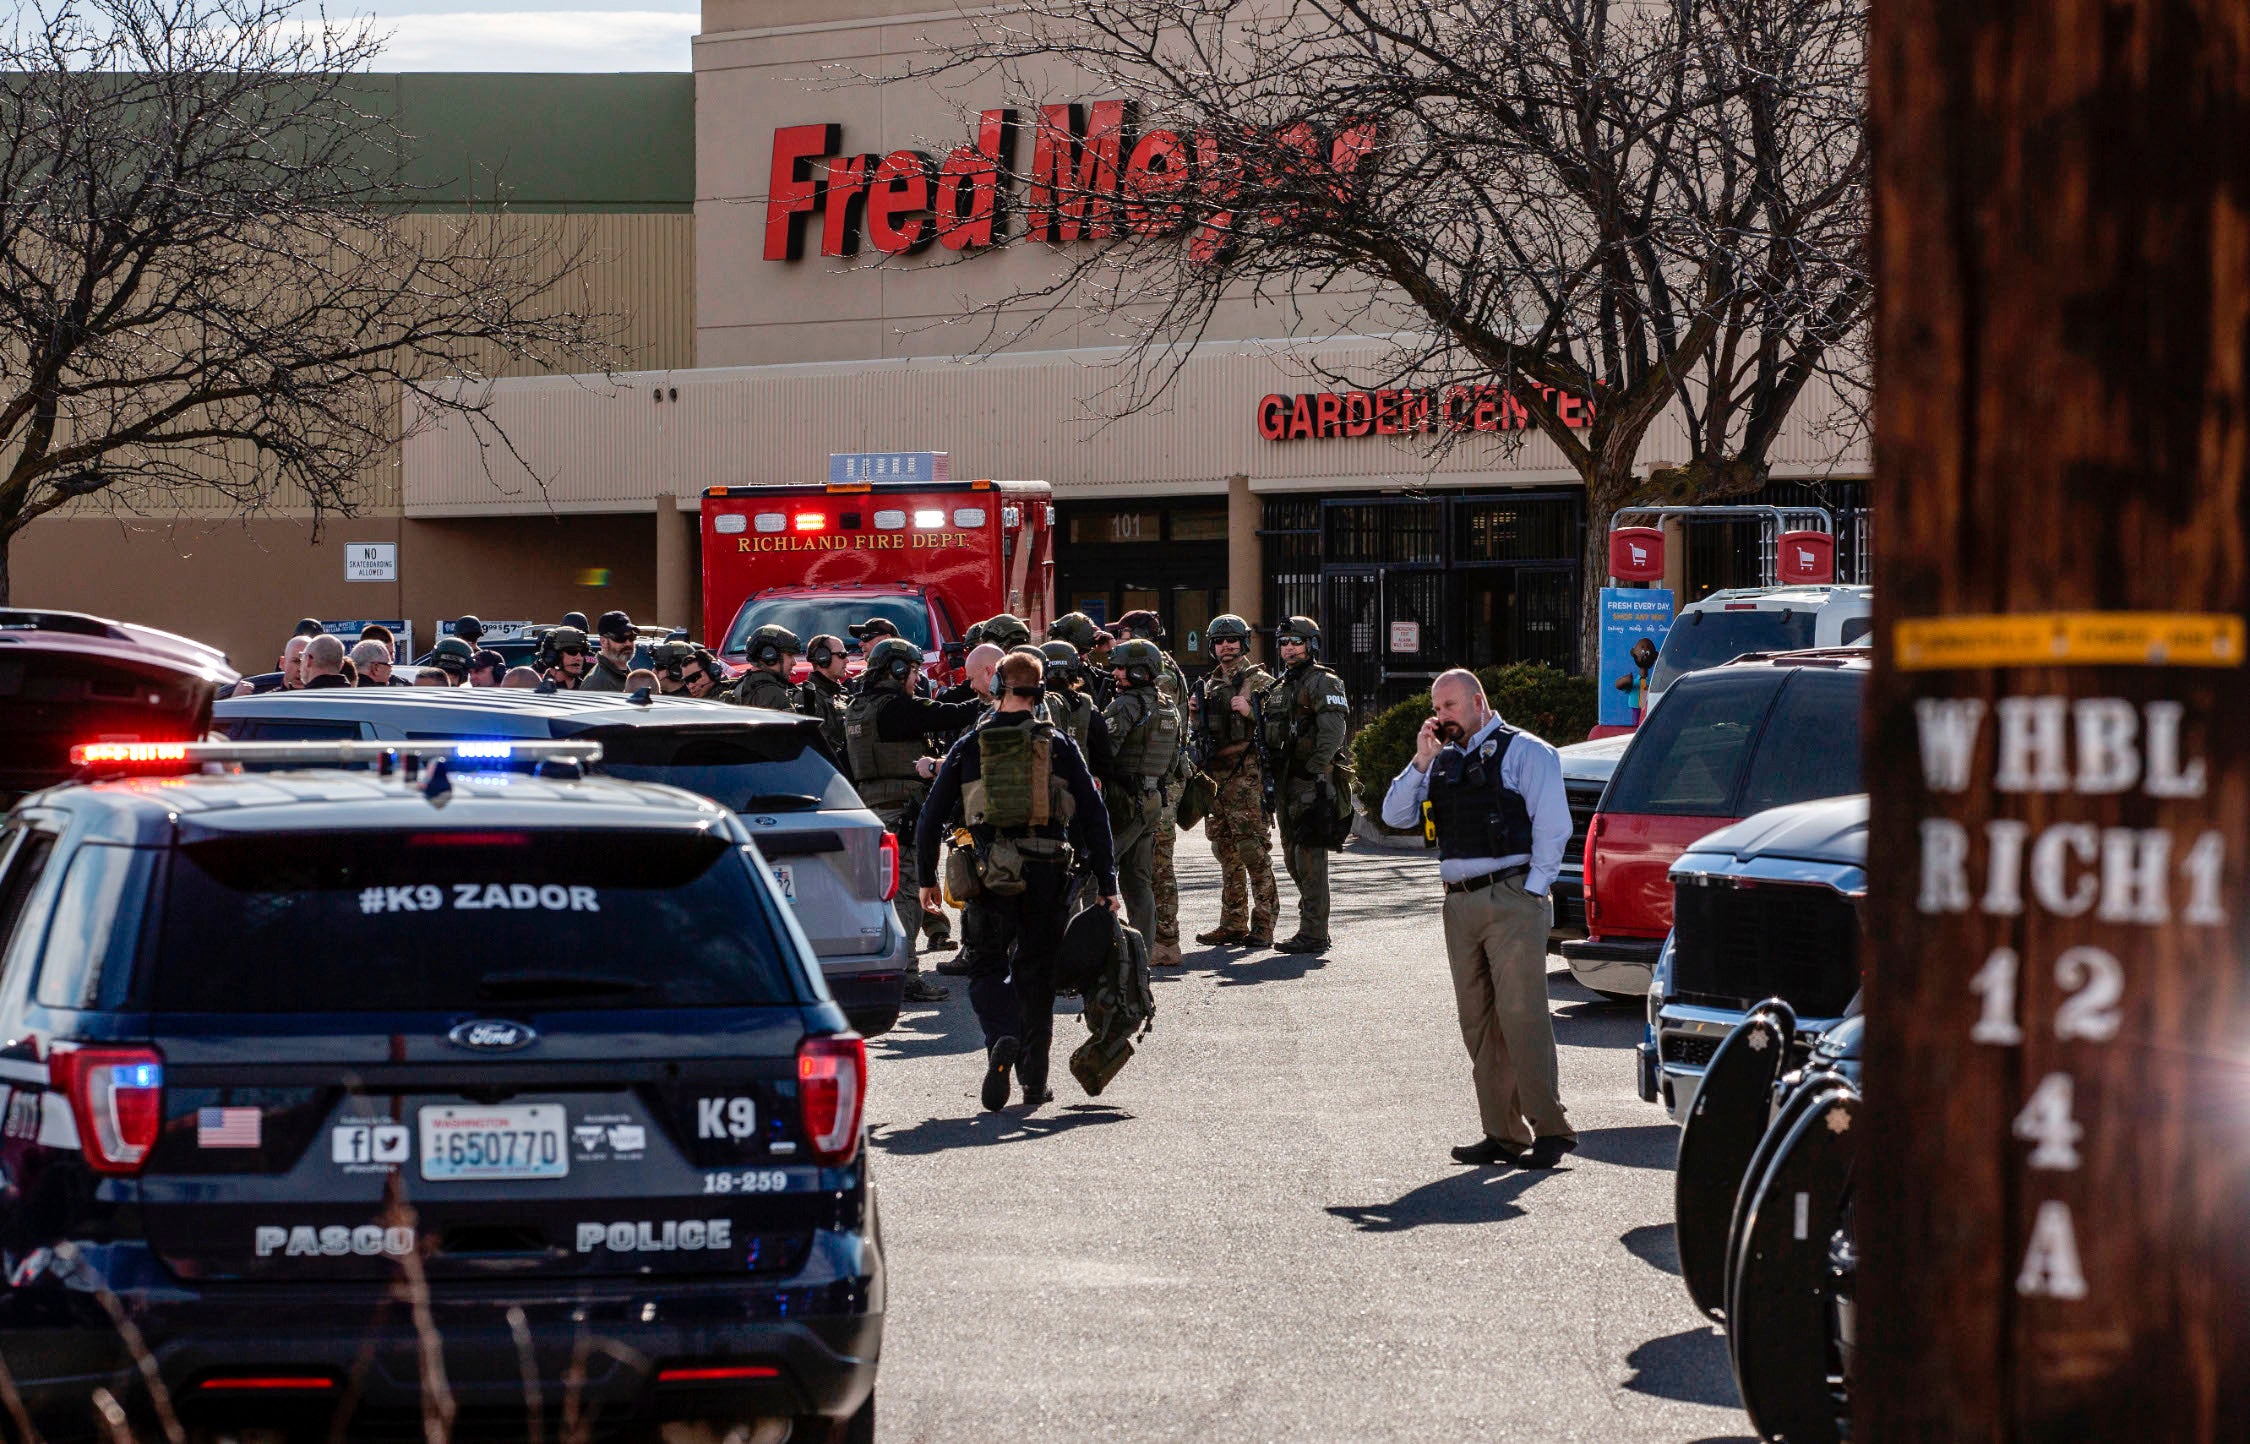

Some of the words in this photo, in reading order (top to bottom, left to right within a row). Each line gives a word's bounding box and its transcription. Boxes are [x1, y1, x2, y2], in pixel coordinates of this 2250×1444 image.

[763, 107, 1014, 262] Fred
[1257, 388, 1433, 441] GARDEN
[1443, 380, 1607, 433] CENE
[1112, 513, 1140, 537] 101
[364, 547, 377, 560] NO
[737, 536, 849, 552] RICHLAND
[854, 534, 905, 550] FIRE
[912, 533, 970, 549] DEPT.
[349, 560, 393, 568] SKATEBOARDING
[358, 568, 384, 577] ALLOWED
[1607, 601, 1632, 610] FRESH
[1634, 602, 1656, 610] EVERY
[1657, 602, 1671, 611] DAY.
[1914, 696, 2207, 798] WHBL
[359, 883, 444, 914] #K9
[452, 883, 600, 912] ZADOR
[468, 1023, 517, 1046] Ford
[432, 1118, 511, 1129] WASHINGTON
[698, 1097, 756, 1139] K9
[2012, 1070, 2085, 1172] 4
[704, 1171, 787, 1193] 18-259
[255, 1225, 415, 1257] PASCO
[576, 1219, 732, 1254] POLICE
[2015, 1199, 2089, 1299] A
